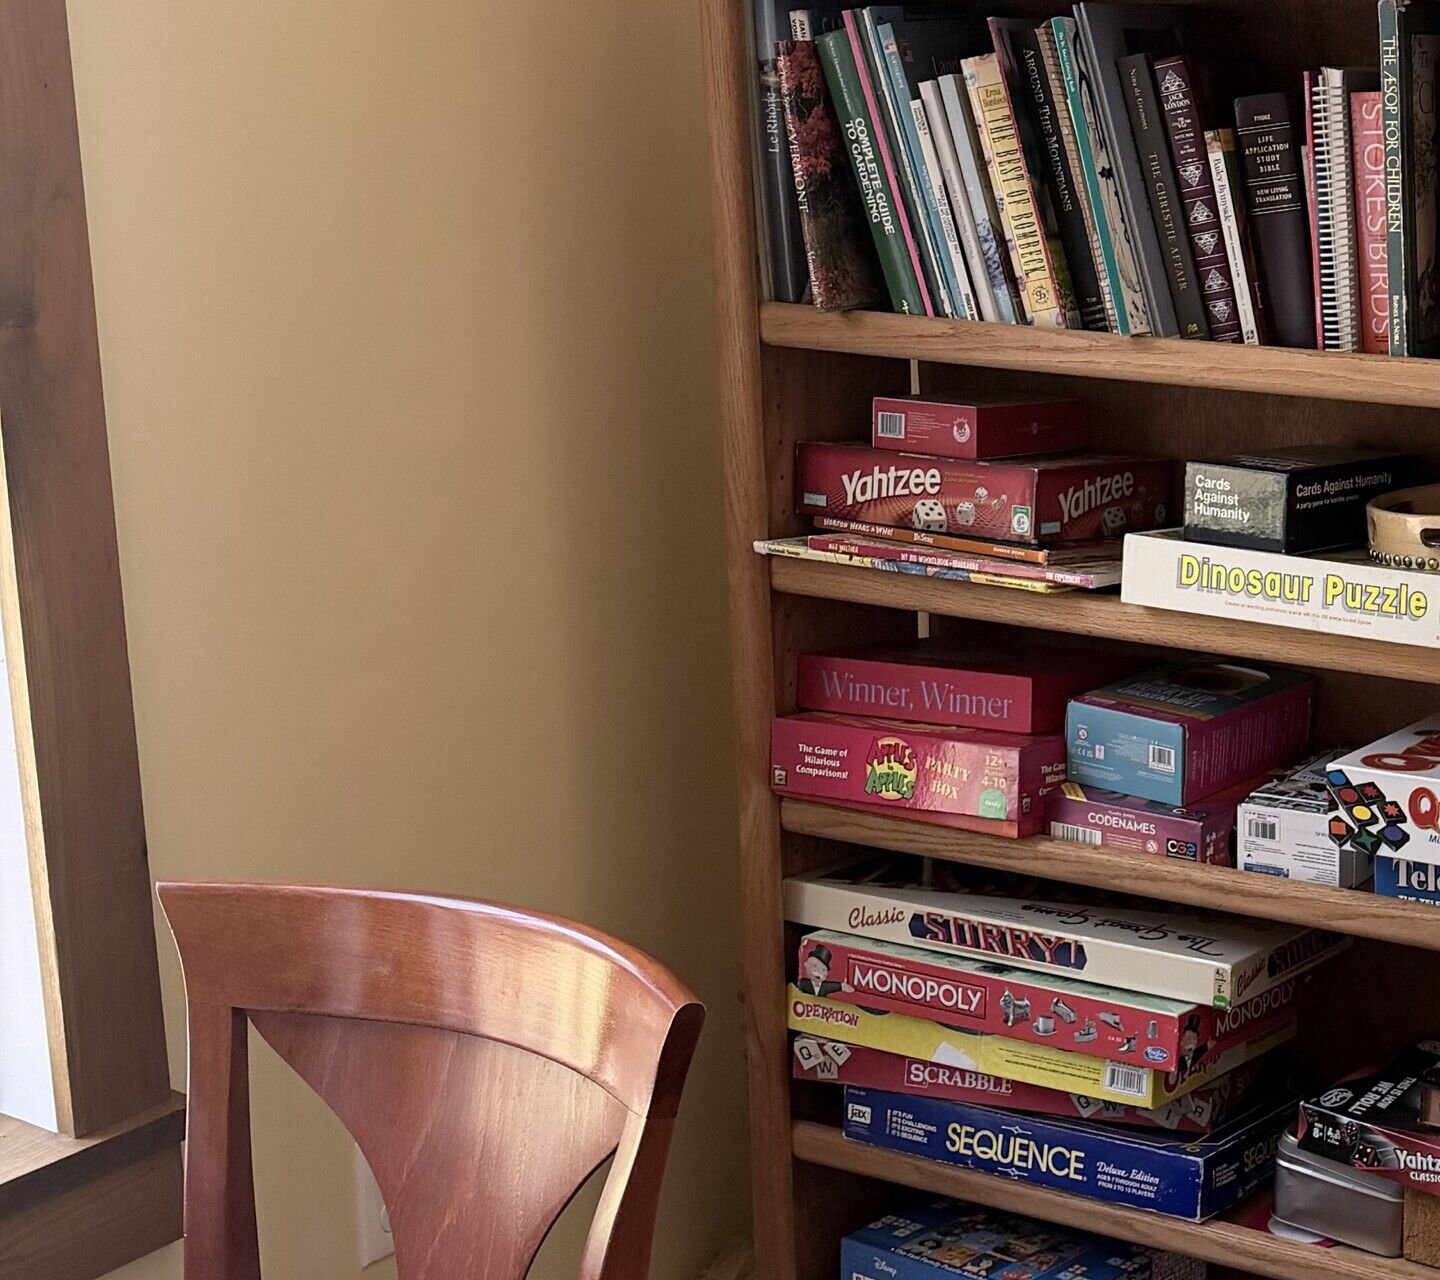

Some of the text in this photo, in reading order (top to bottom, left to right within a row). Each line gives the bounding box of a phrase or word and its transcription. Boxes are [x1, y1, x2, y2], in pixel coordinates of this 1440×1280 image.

[1382, 35, 1398, 67] THE
[1163, 99, 1192, 111] LONDON
[1023, 48, 1045, 103] AROUND
[1046, 134, 1073, 213] MOUNTAINS
[1257, 135, 1274, 144] LIFE
[1385, 120, 1399, 152] FOR
[1244, 143, 1290, 156] APPLICATION
[1256, 154, 1281, 164] STUDY
[787, 129, 810, 213] VERMONT
[845, 121, 881, 223] TO GARDENING
[854, 117, 895, 236] COMPLETE GUIDE
[1259, 163, 1281, 173] BIBLE
[988, 115, 1047, 277] THE BEST OF BOMBECK
[1255, 192, 1293, 204] TRANSLATION
[1256, 185, 1290, 196] NEW LIVING
[1386, 156, 1402, 233] CHILDREN
[1149, 152, 1188, 291] THE CHRISTIE AFFAIR
[1368, 242, 1390, 334] BIRDS
[841, 465, 942, 507] Yahtzee
[1057, 470, 1135, 515] Yahtzee
[1195, 474, 1231, 490] Cards
[1296, 472, 1393, 498] Cards Against Humanity
[1194, 490, 1239, 507] Against
[823, 518, 848, 528] HORTON
[850, 521, 870, 532] HEARS
[1194, 504, 1250, 524] Humanity
[1178, 554, 1314, 603] Dinosaur
[1322, 573, 1428, 619] Puzzle
[822, 670, 1013, 719] Winner, Winner
[798, 744, 848, 758] The Game of
[804, 755, 841, 768] Hilarious
[795, 765, 849, 780] Comparisons!
[925, 754, 972, 782] PARTY
[931, 779, 961, 800] BOX
[981, 776, 1006, 789] 4-10
[1087, 812, 1157, 836] CODENAMES
[848, 906, 1080, 971] Classic SORRY!
[852, 964, 983, 1013] MONOPOLY
[792, 1000, 860, 1027] OPERATION
[1215, 979, 1296, 1038] MONOPOLY
[799, 1045, 814, 1061] Q
[909, 1062, 1014, 1096] SCRABBLE
[850, 1104, 867, 1121] jax
[945, 1121, 1088, 1182] SEQUENCE
[1096, 1161, 1160, 1185] Deluxe Edition
[873, 1256, 898, 1277] Disney
